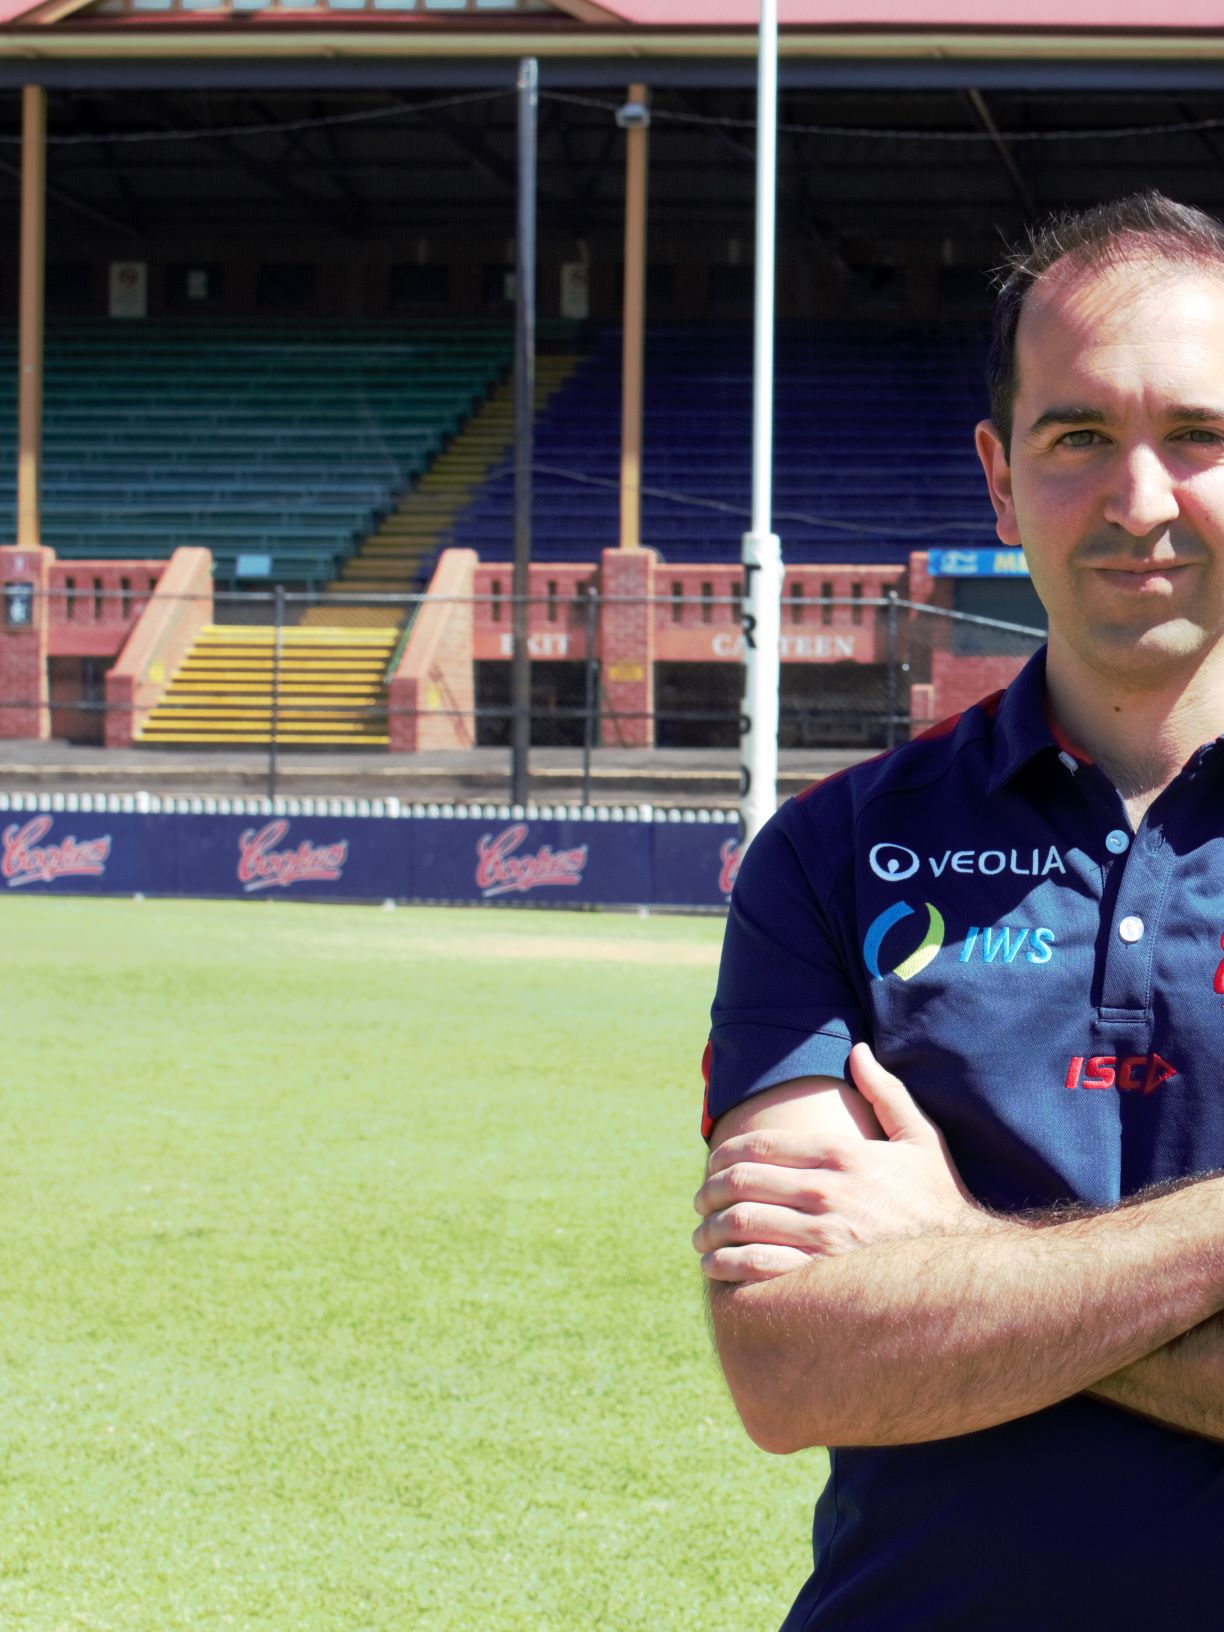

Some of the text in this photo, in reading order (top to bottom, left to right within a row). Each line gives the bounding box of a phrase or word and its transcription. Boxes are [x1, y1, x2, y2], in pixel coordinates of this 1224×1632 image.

[711, 634, 855, 656] CTEEN
[928, 845, 1067, 877] VEOLIA
[958, 925, 1056, 965] IWS
[1065, 1056, 1148, 1089] ISC
